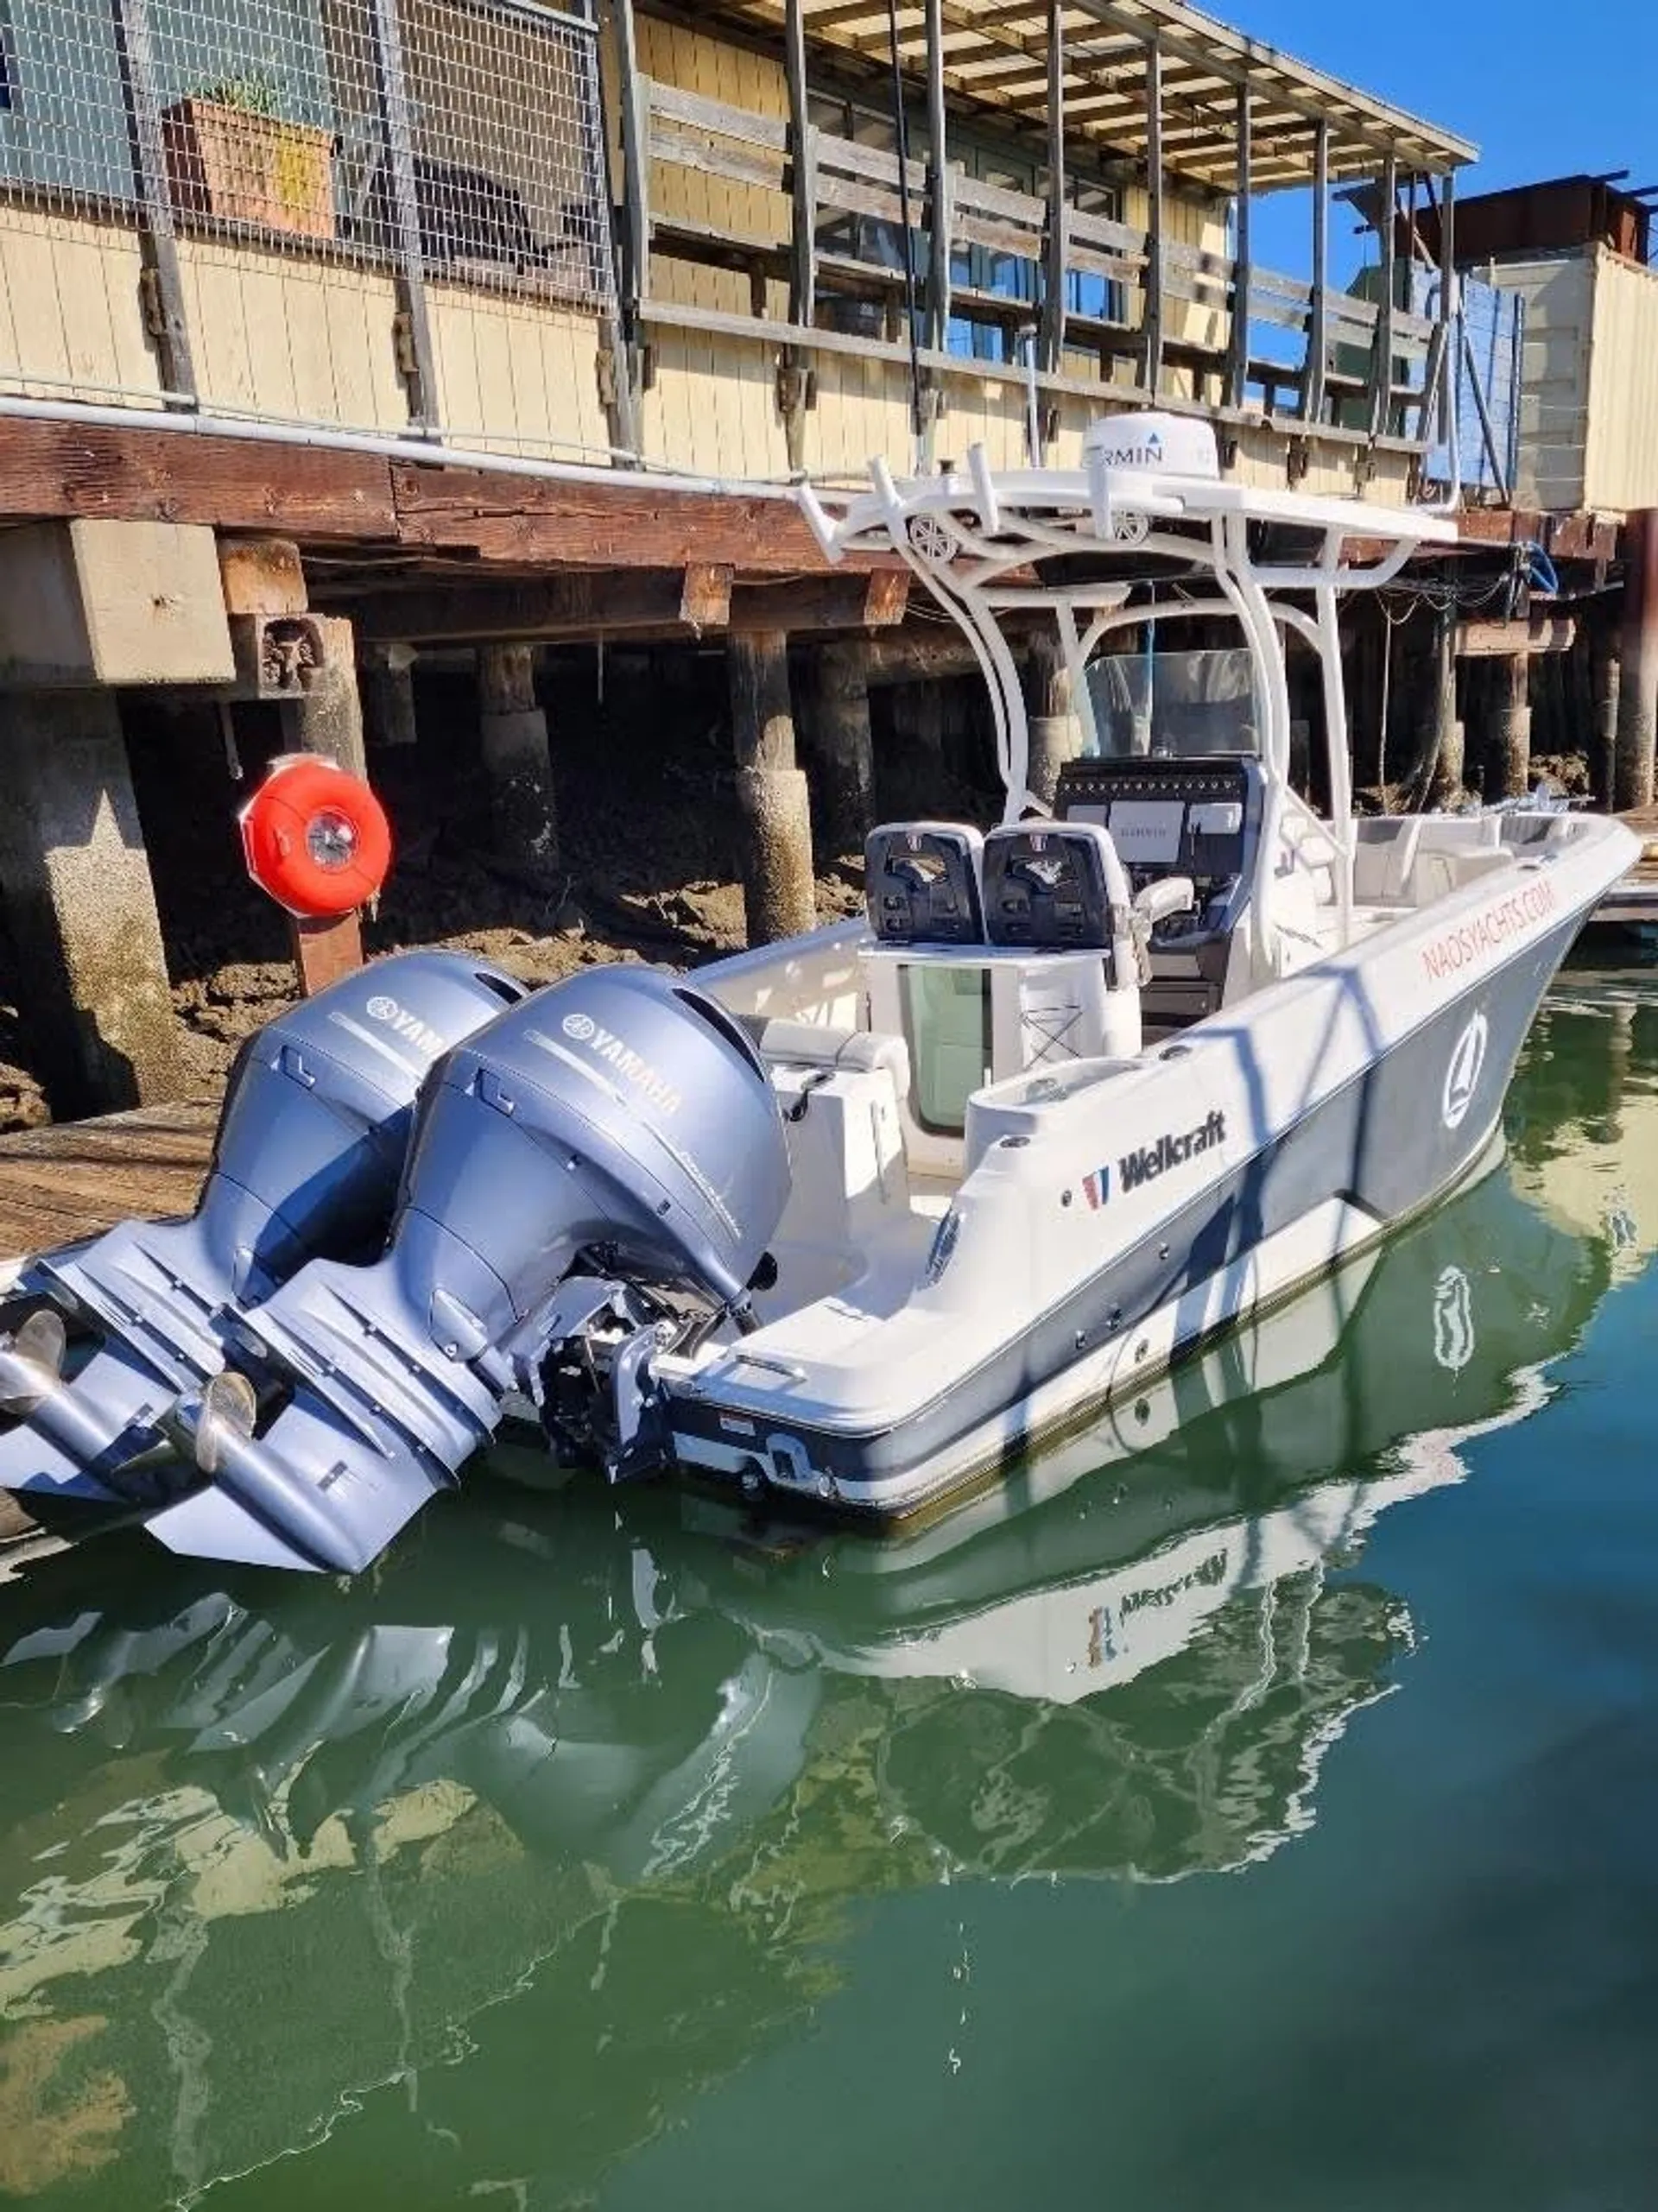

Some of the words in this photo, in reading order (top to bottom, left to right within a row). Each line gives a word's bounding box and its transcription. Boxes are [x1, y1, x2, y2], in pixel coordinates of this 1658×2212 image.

[1103, 446, 1162, 466] RMIN
[392, 1008, 445, 1053] YAM
[591, 1027, 681, 1114] YAMAHA
[1117, 1109, 1226, 1194] Wellcraft
